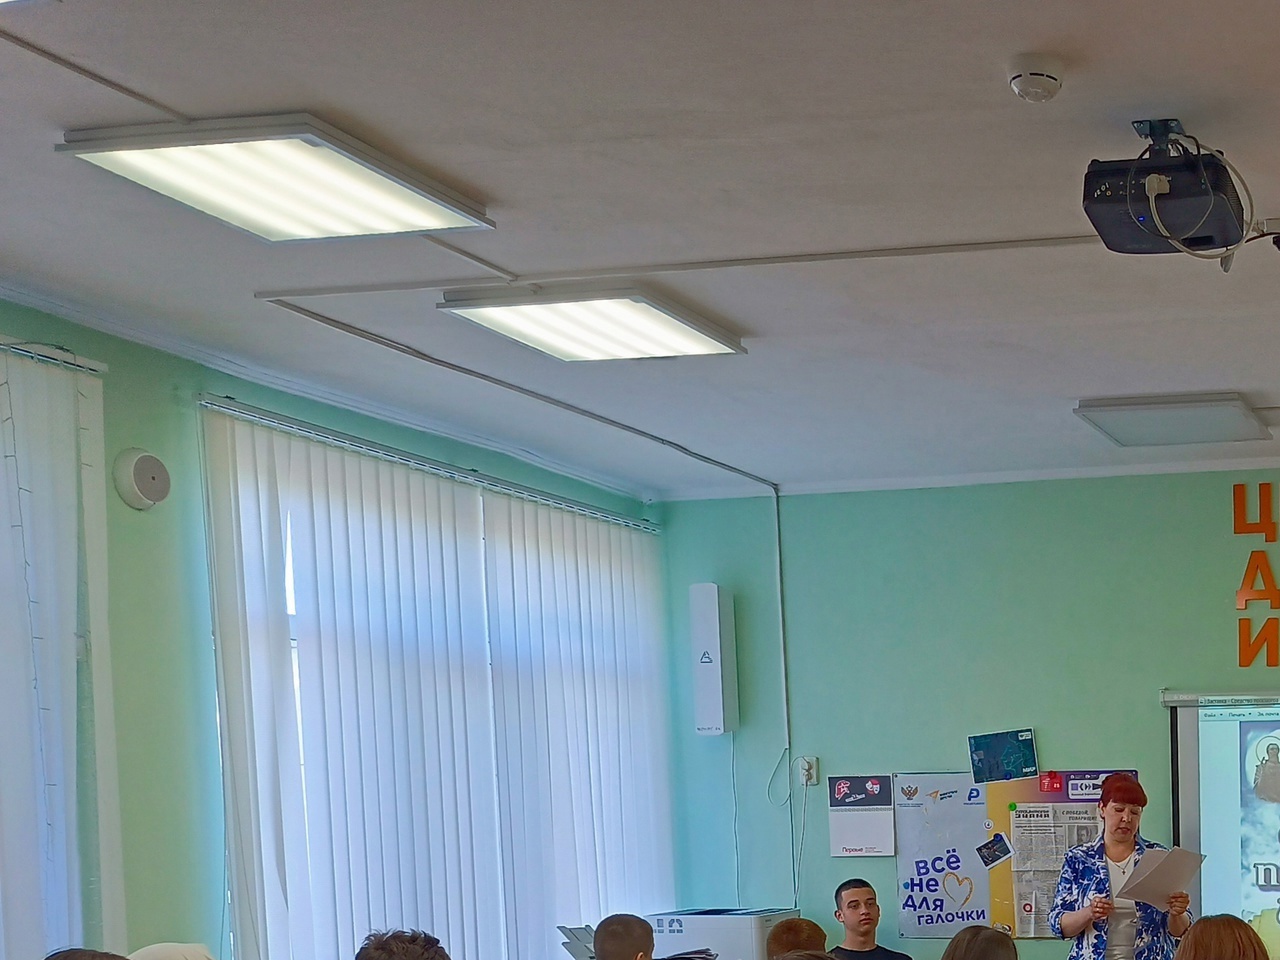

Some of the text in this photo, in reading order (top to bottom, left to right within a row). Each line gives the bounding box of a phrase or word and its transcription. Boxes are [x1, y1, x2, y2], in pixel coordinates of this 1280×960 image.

[915, 848, 961, 876] всё
[910, 877, 940, 893] не
[902, 894, 945, 912] для
[916, 909, 986, 926] галочки
